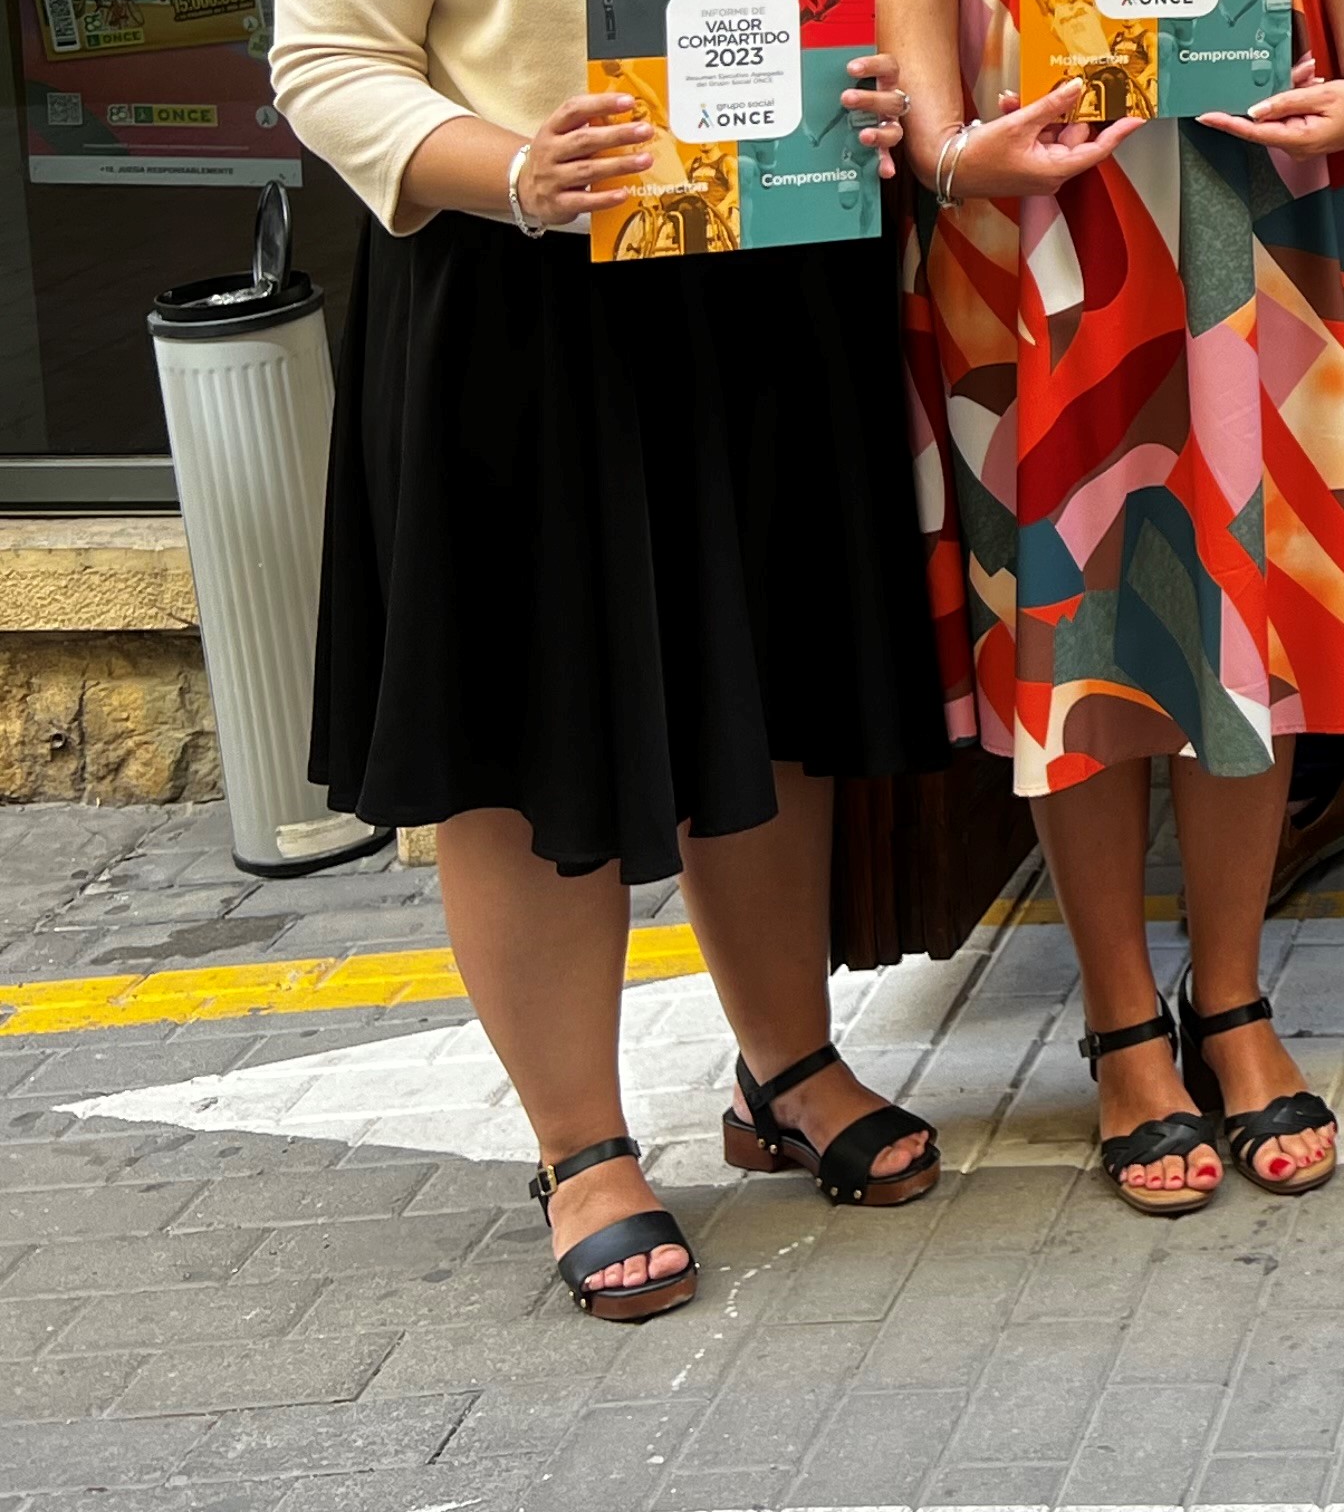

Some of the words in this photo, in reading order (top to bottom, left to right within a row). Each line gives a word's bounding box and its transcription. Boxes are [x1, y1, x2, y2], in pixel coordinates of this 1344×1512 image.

[705, 19, 762, 33] VALOR
[102, 30, 142, 44] ONCE
[678, 31, 790, 49] COMPARTIDO
[705, 47, 764, 68] 2023
[1179, 48, 1270, 63] Compromiso
[716, 102, 746, 111] grupo
[157, 109, 211, 123] ONCE
[717, 110, 775, 127] ONCE
[761, 169, 858, 188] Compromiso
